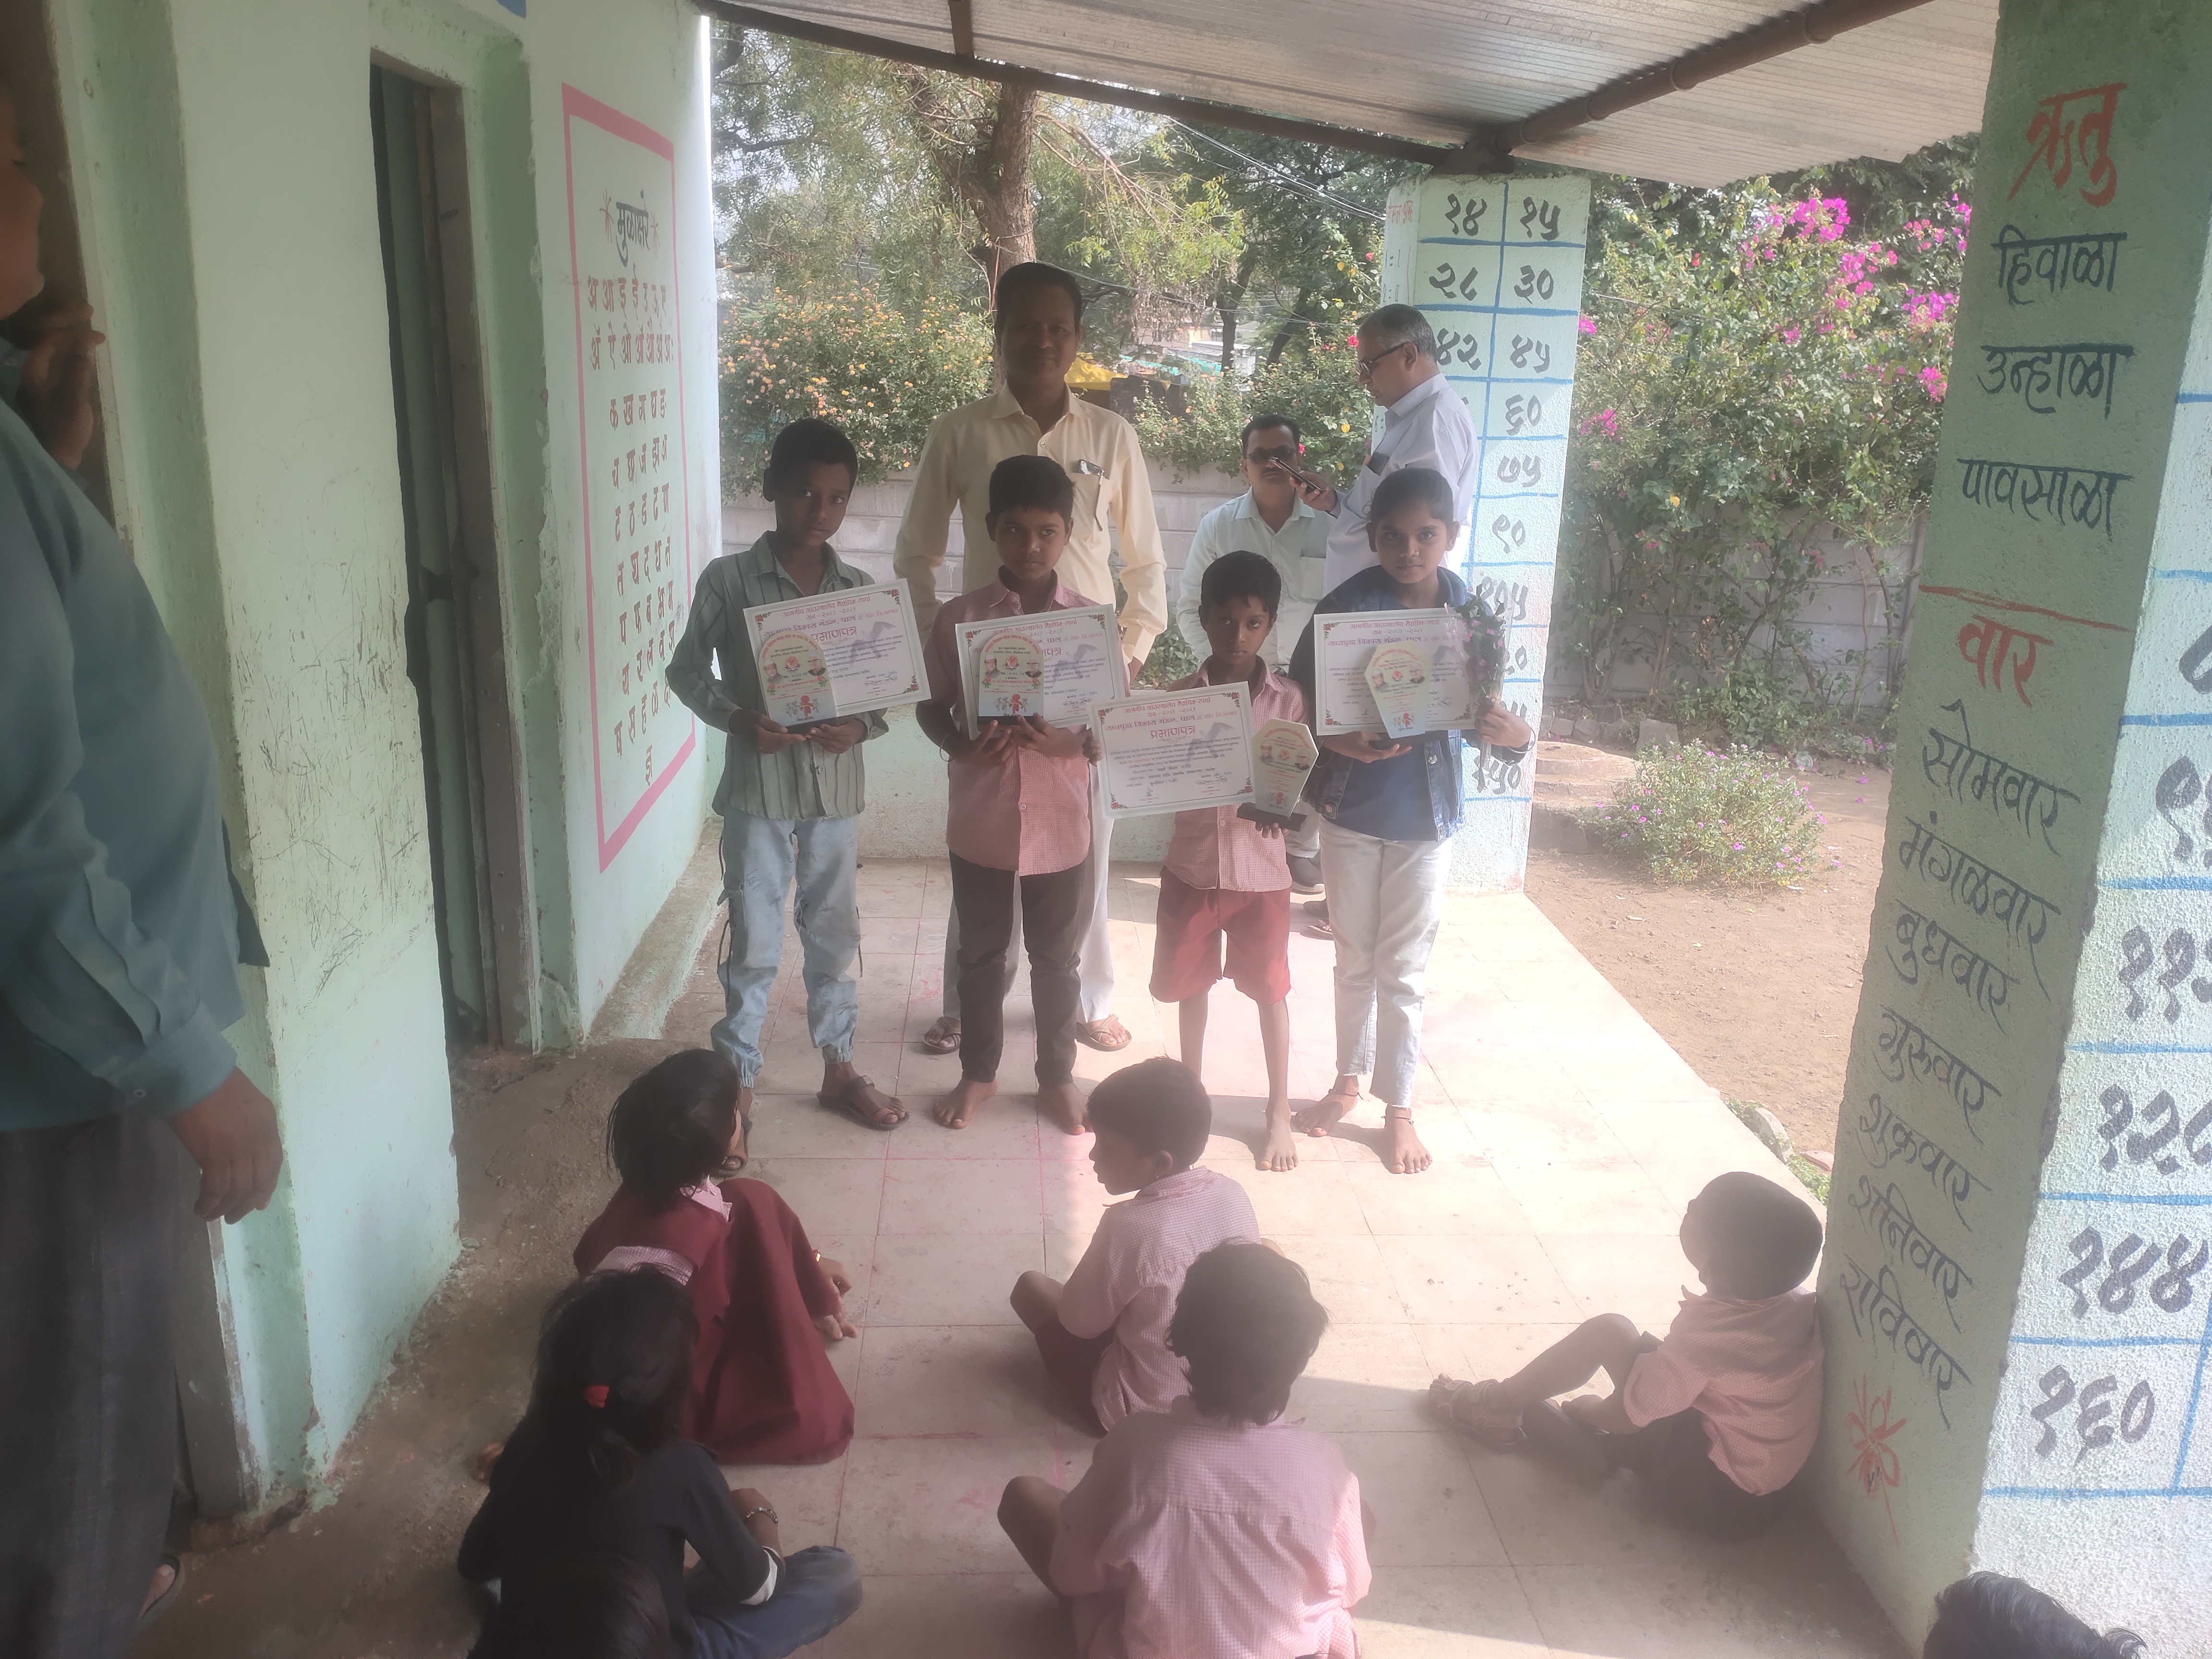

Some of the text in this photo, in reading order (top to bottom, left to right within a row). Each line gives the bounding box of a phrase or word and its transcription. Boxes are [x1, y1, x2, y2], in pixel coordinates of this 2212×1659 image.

[2007, 82, 2127, 207] ऋतु
[1445, 193, 1487, 236] १४
[1520, 196, 1561, 240] १५
[1429, 262, 1479, 301] २८
[1514, 265, 1554, 304] ३०
[1991, 224, 2127, 306] हिवाळा
[1437, 328, 1482, 371] ४२
[1510, 335, 1550, 372] ४५
[1976, 344, 2134, 419] उन्हाळा
[610, 398, 618, 431] क
[624, 394, 634, 426] ख
[638, 394, 646, 424] ग
[1505, 394, 1542, 436] ६०
[612, 457, 619, 489] च
[639, 443, 647, 474] ज
[1497, 455, 1541, 487] ७५
[615, 505, 621, 541] ट
[629, 500, 635, 537] ठ
[642, 492, 647, 526] ड
[1957, 457, 2134, 543] पावसाळा
[1492, 514, 1526, 553] ९०
[617, 561, 624, 597] त
[644, 545, 650, 583] द
[620, 611, 627, 645] प
[622, 662, 629, 696] य
[637, 649, 643, 682] र
[1958, 613, 2055, 708] वार
[1150, 726, 1195, 739] प्रमाणपत्र
[1923, 698, 2081, 857] सोमवार
[1899, 811, 2061, 1003] मंगळवार
[1885, 899, 2020, 1035] बुधवार
[1855, 1093, 1993, 1233] शुक्रवार
[1848, 1175, 1972, 1334] शनिवार
[2058, 1226, 2209, 1318] १४४
[1839, 1253, 1972, 1431] रविवार
[2030, 1364, 2155, 1466] १६०
